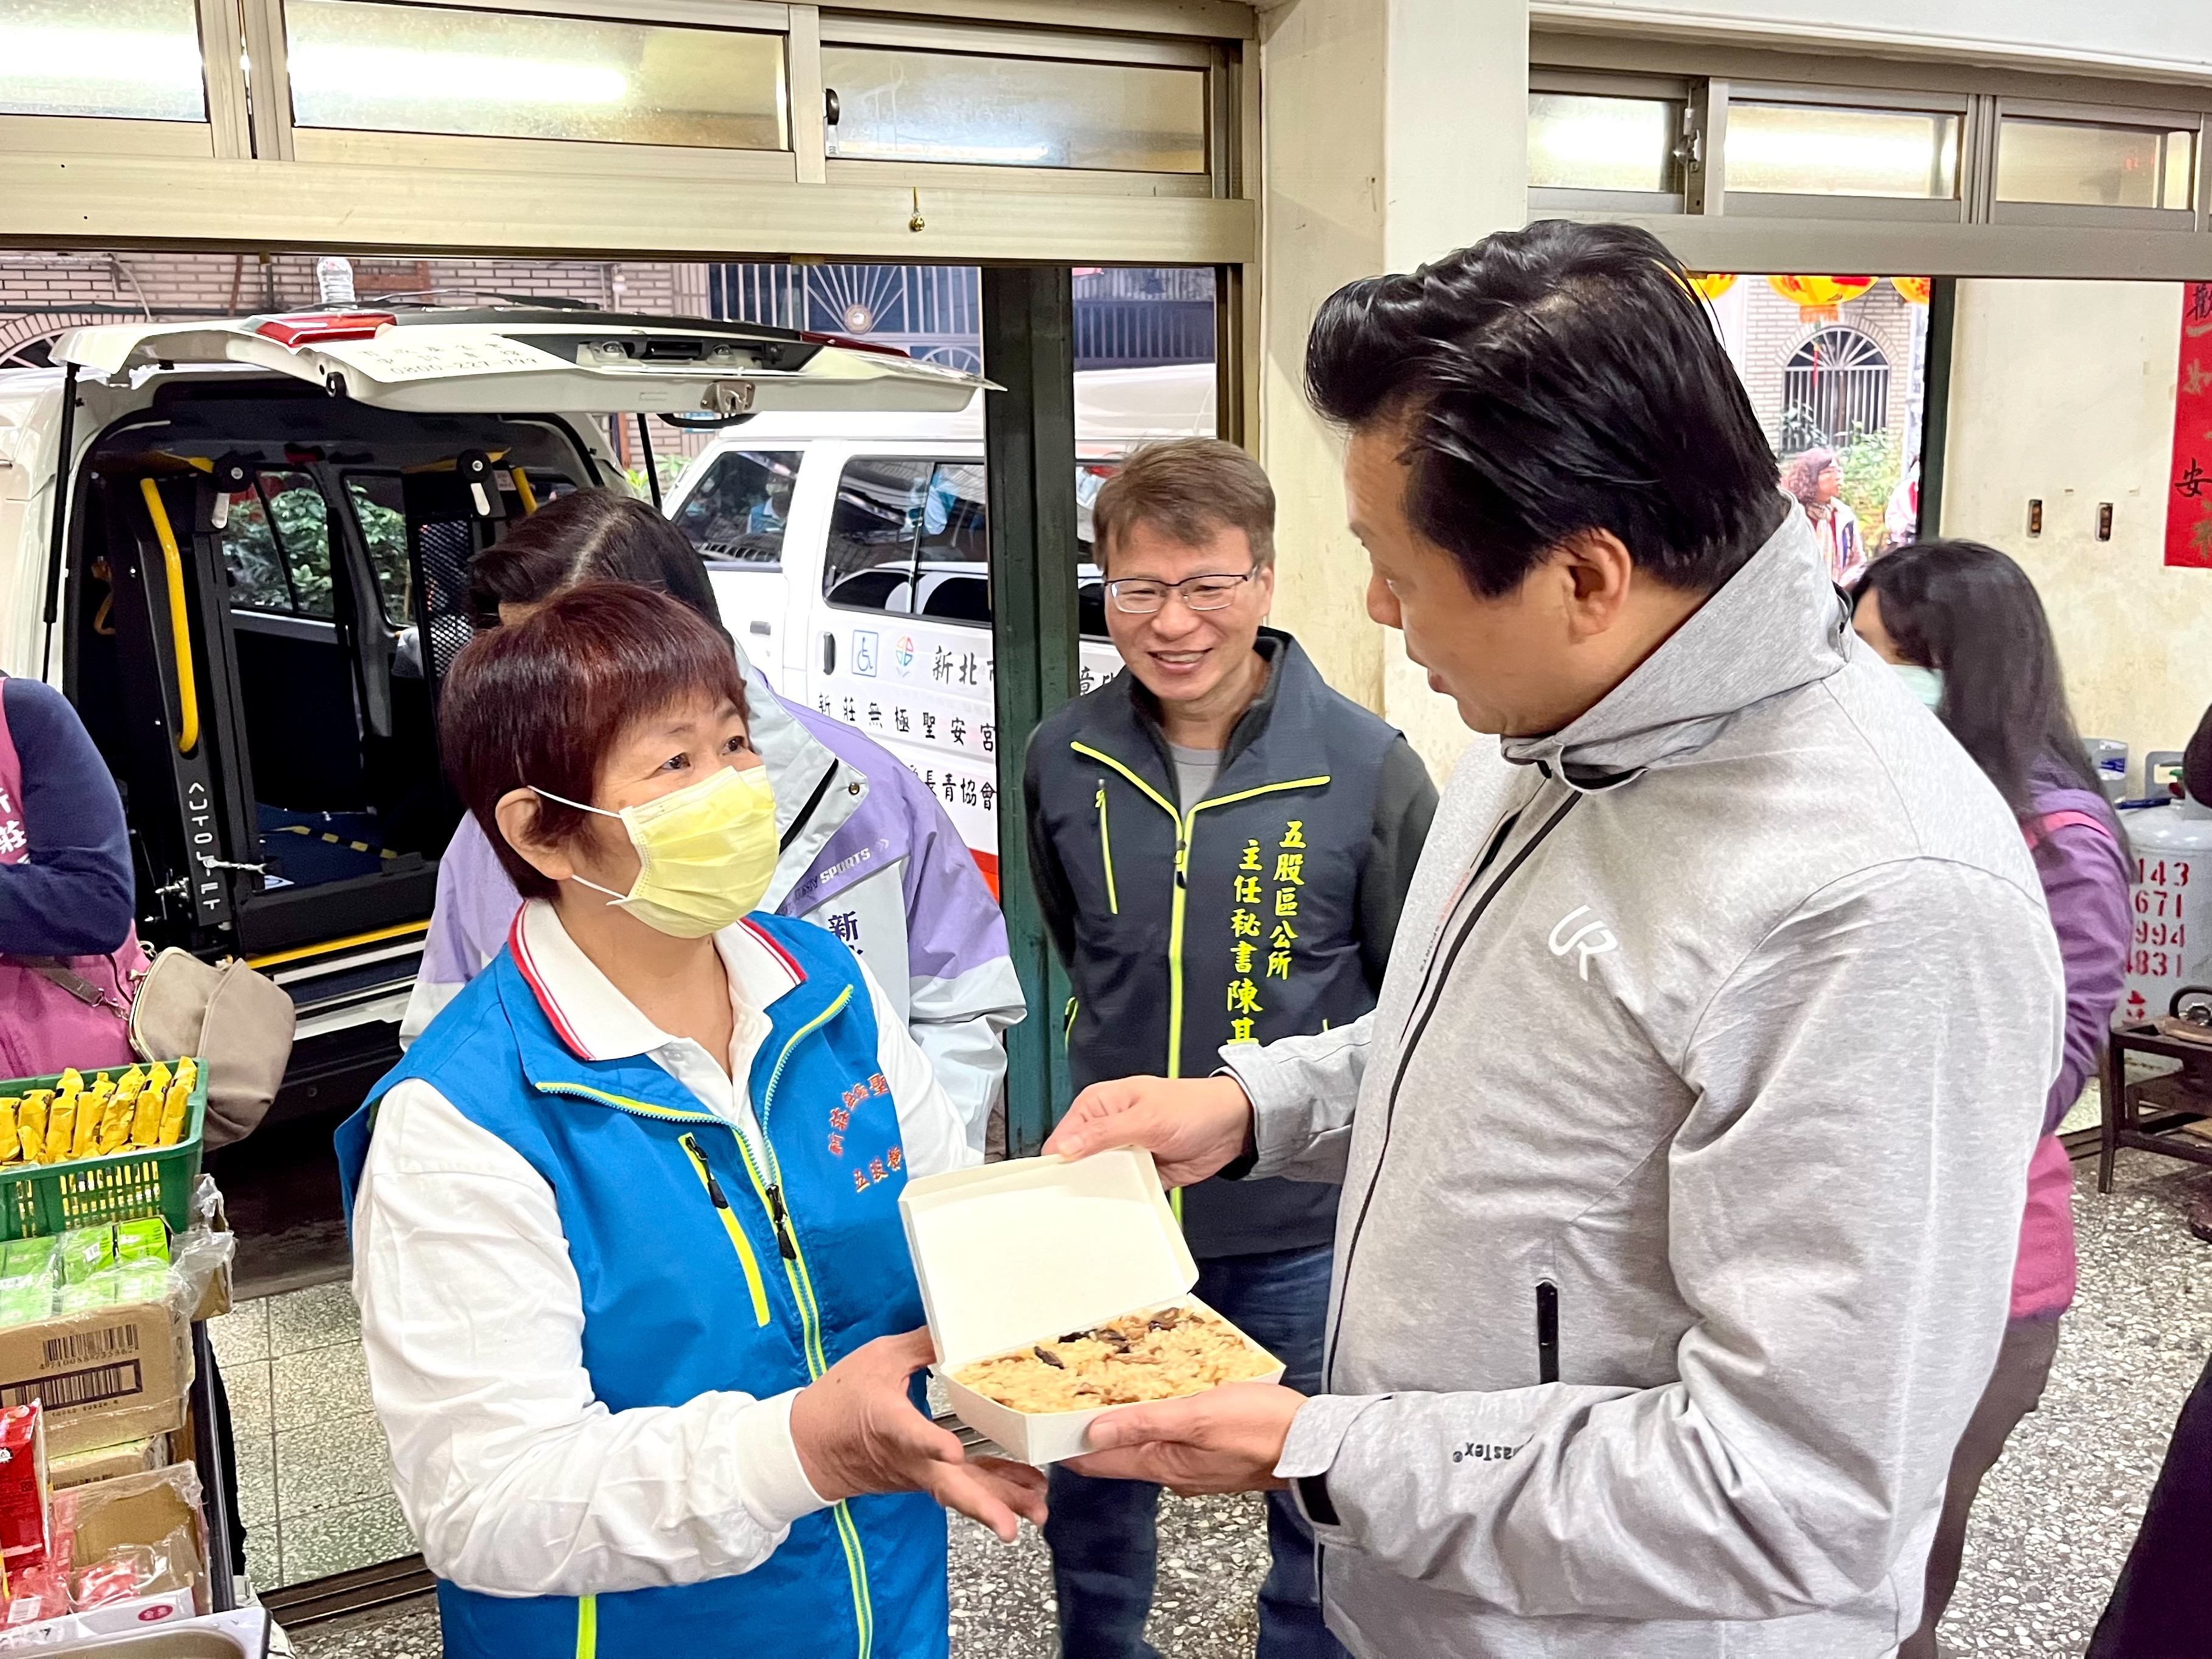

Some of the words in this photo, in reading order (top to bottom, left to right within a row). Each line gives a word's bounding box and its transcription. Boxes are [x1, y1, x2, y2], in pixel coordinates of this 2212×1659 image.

[909, 765, 996, 811] 長青協會
[2138, 858, 2189, 886] 143
[1266, 820, 1307, 981] 五股區公所
[2135, 890, 2182, 919] 671
